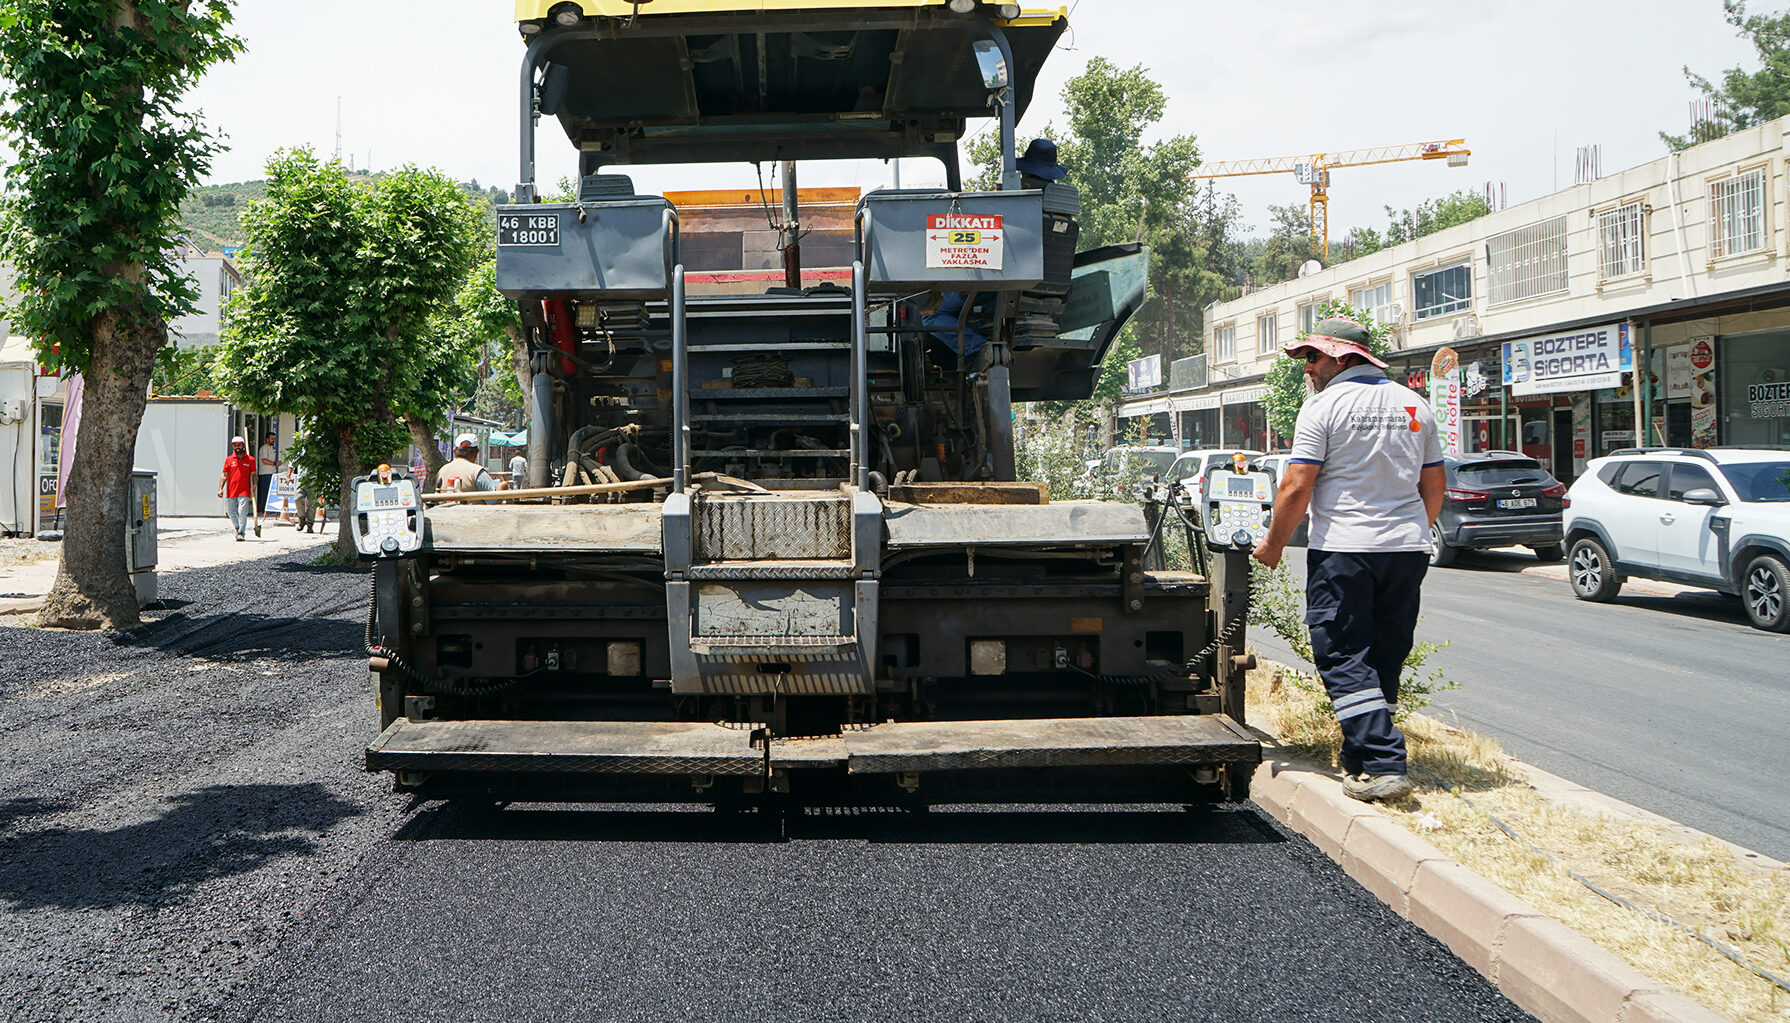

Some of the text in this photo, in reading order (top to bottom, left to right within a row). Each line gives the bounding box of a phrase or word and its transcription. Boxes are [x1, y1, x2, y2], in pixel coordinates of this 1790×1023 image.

[501, 217, 557, 229] 46 KBB
[935, 215, 995, 229] DİKKAT!
[511, 231, 555, 243] 18001
[953, 232, 976, 243] 25
[1534, 331, 1608, 356] BOZTEPE
[1446, 383, 1458, 427] köfte
